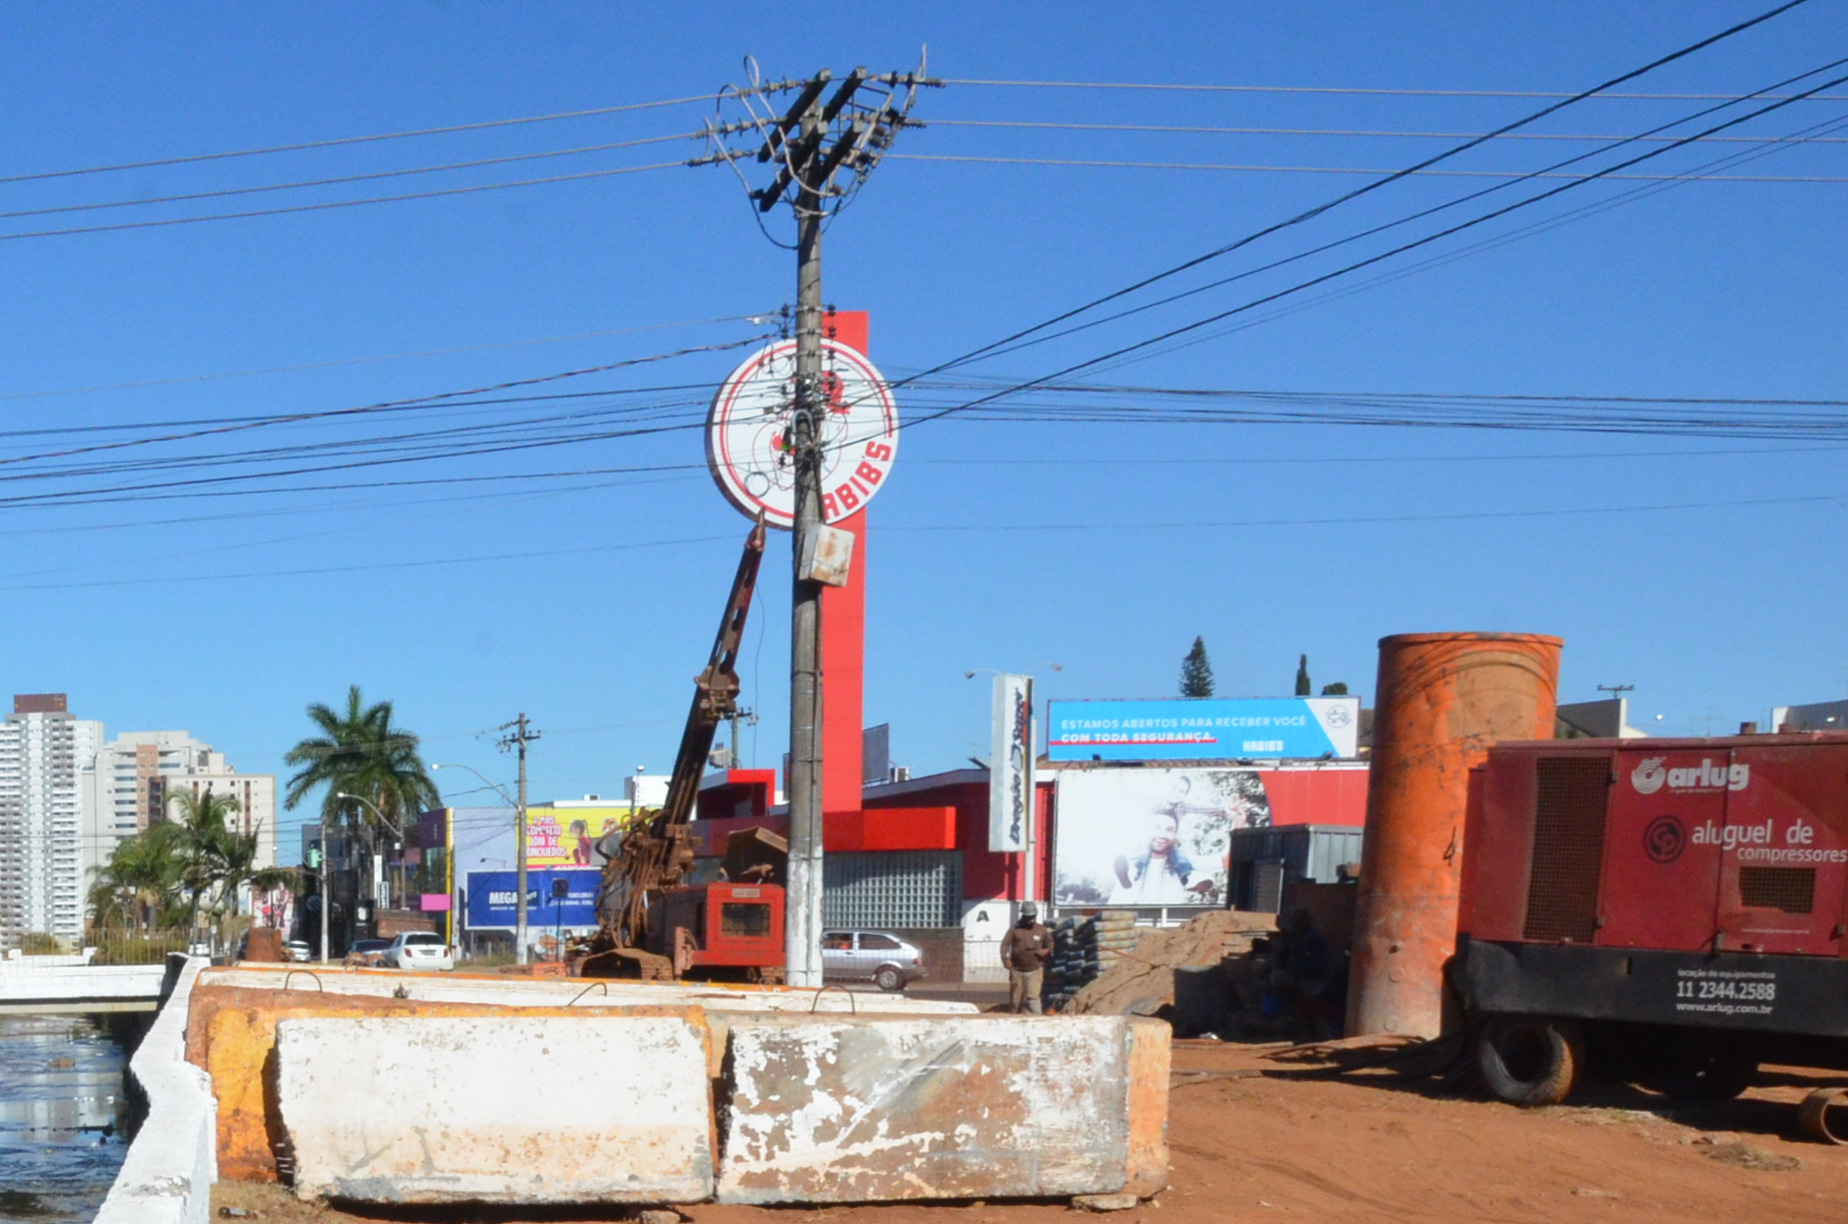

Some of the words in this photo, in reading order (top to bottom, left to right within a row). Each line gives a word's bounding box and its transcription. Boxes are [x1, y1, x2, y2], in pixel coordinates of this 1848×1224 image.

[822, 440, 892, 520] ABIB'S
[1061, 719, 1119, 729] ESTAMOS
[1121, 718, 1179, 729] ABERTOS
[1181, 717, 1213, 728] PARA
[1215, 716, 1271, 727] RECEBER
[1273, 714, 1307, 727] VOCÊ
[1061, 733, 1091, 743] COM
[1094, 732, 1129, 743] TODA
[1132, 731, 1216, 744] SEGURANÇA.
[1667, 758, 1750, 791] arlug
[1692, 818, 1773, 850] aluguel
[1786, 818, 1814, 844] de
[1736, 848, 1848, 864] compressores
[1676, 981, 1694, 998] 11
[1699, 981, 1777, 1001] 2344.2588
[1676, 1003, 1773, 1015] www.arlug.com.br
